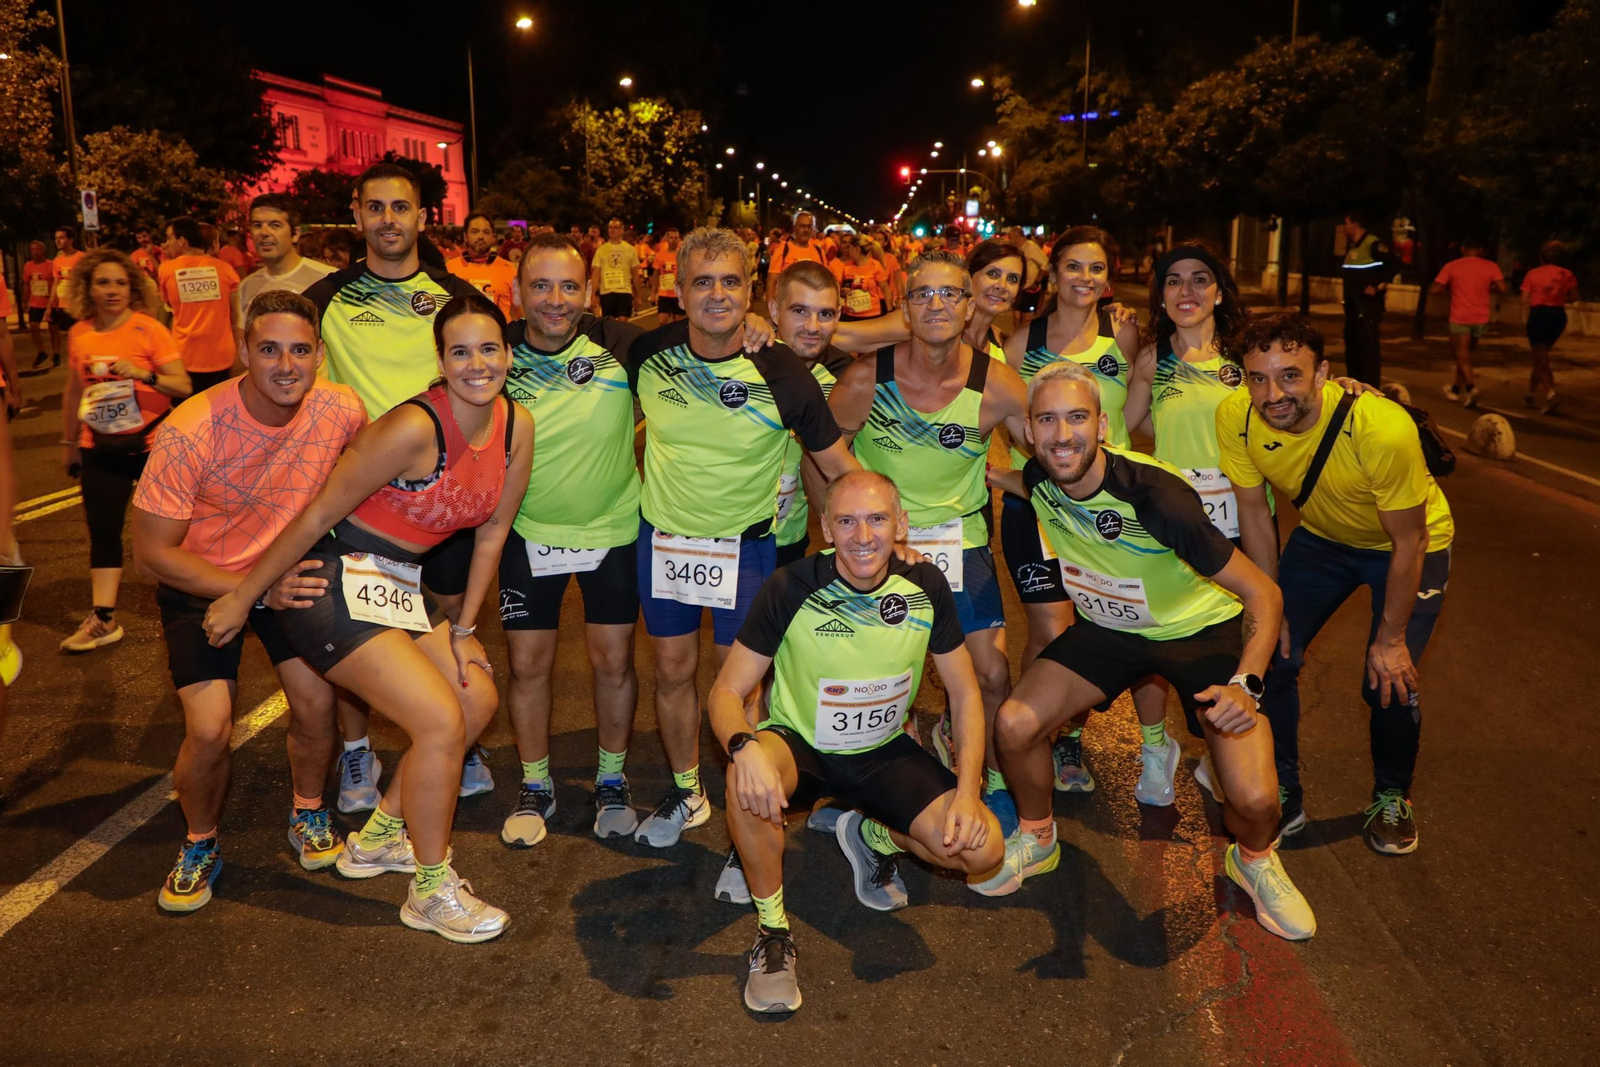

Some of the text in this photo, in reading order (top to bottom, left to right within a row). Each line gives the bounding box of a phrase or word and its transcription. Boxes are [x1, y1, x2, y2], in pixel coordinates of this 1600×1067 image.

[181, 281, 217, 293] 13269
[665, 560, 723, 587] 3469
[357, 584, 413, 612] 4346
[1078, 592, 1139, 621] 3155
[832, 704, 898, 731] 3156
